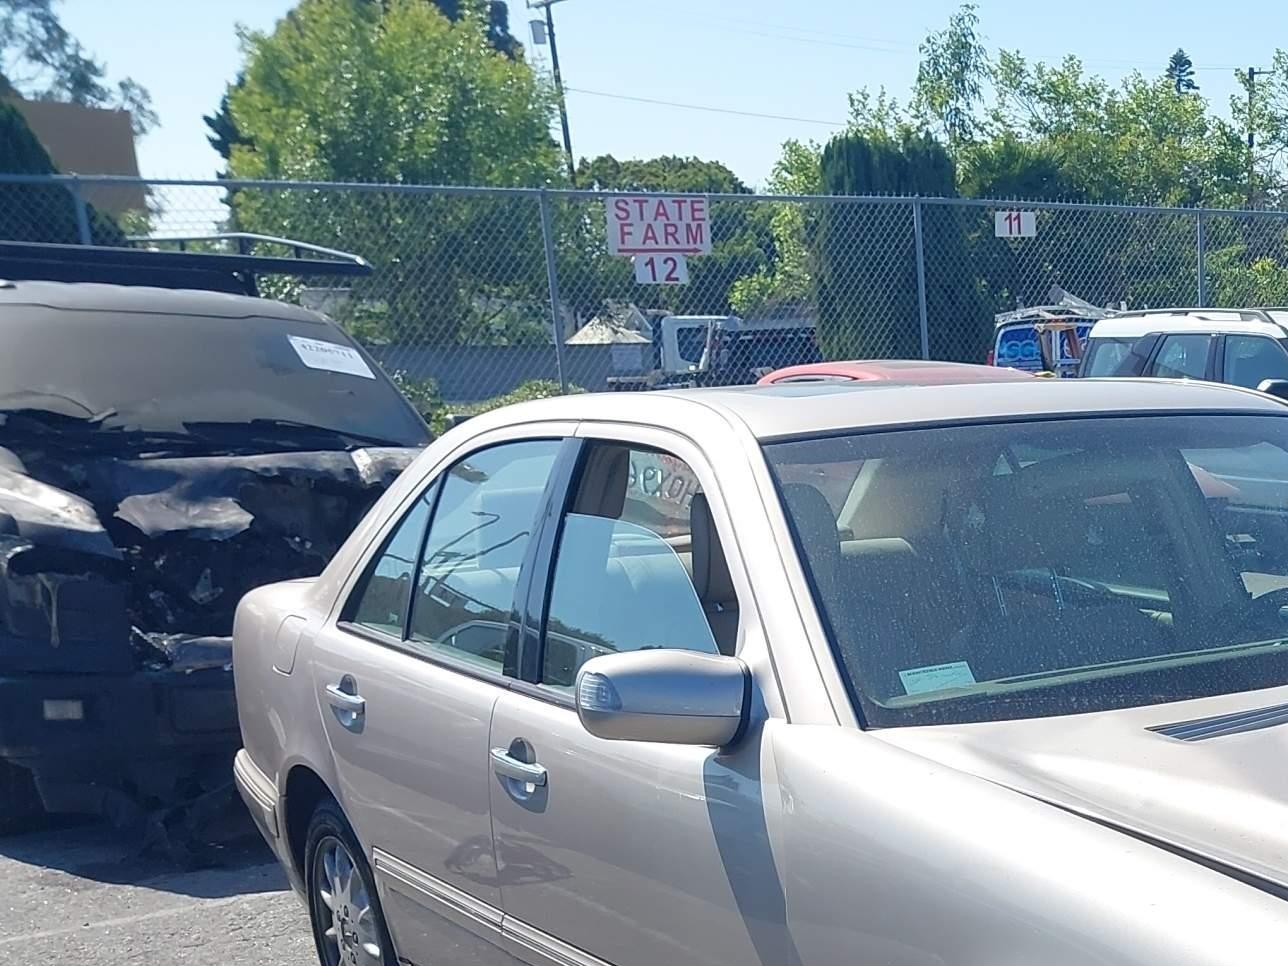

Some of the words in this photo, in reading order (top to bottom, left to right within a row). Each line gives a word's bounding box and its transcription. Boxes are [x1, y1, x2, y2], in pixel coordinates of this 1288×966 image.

[614, 198, 705, 222] STATE
[619, 223, 704, 245] FARM
[1004, 212, 1021, 236] 11
[644, 257, 680, 282] 12
